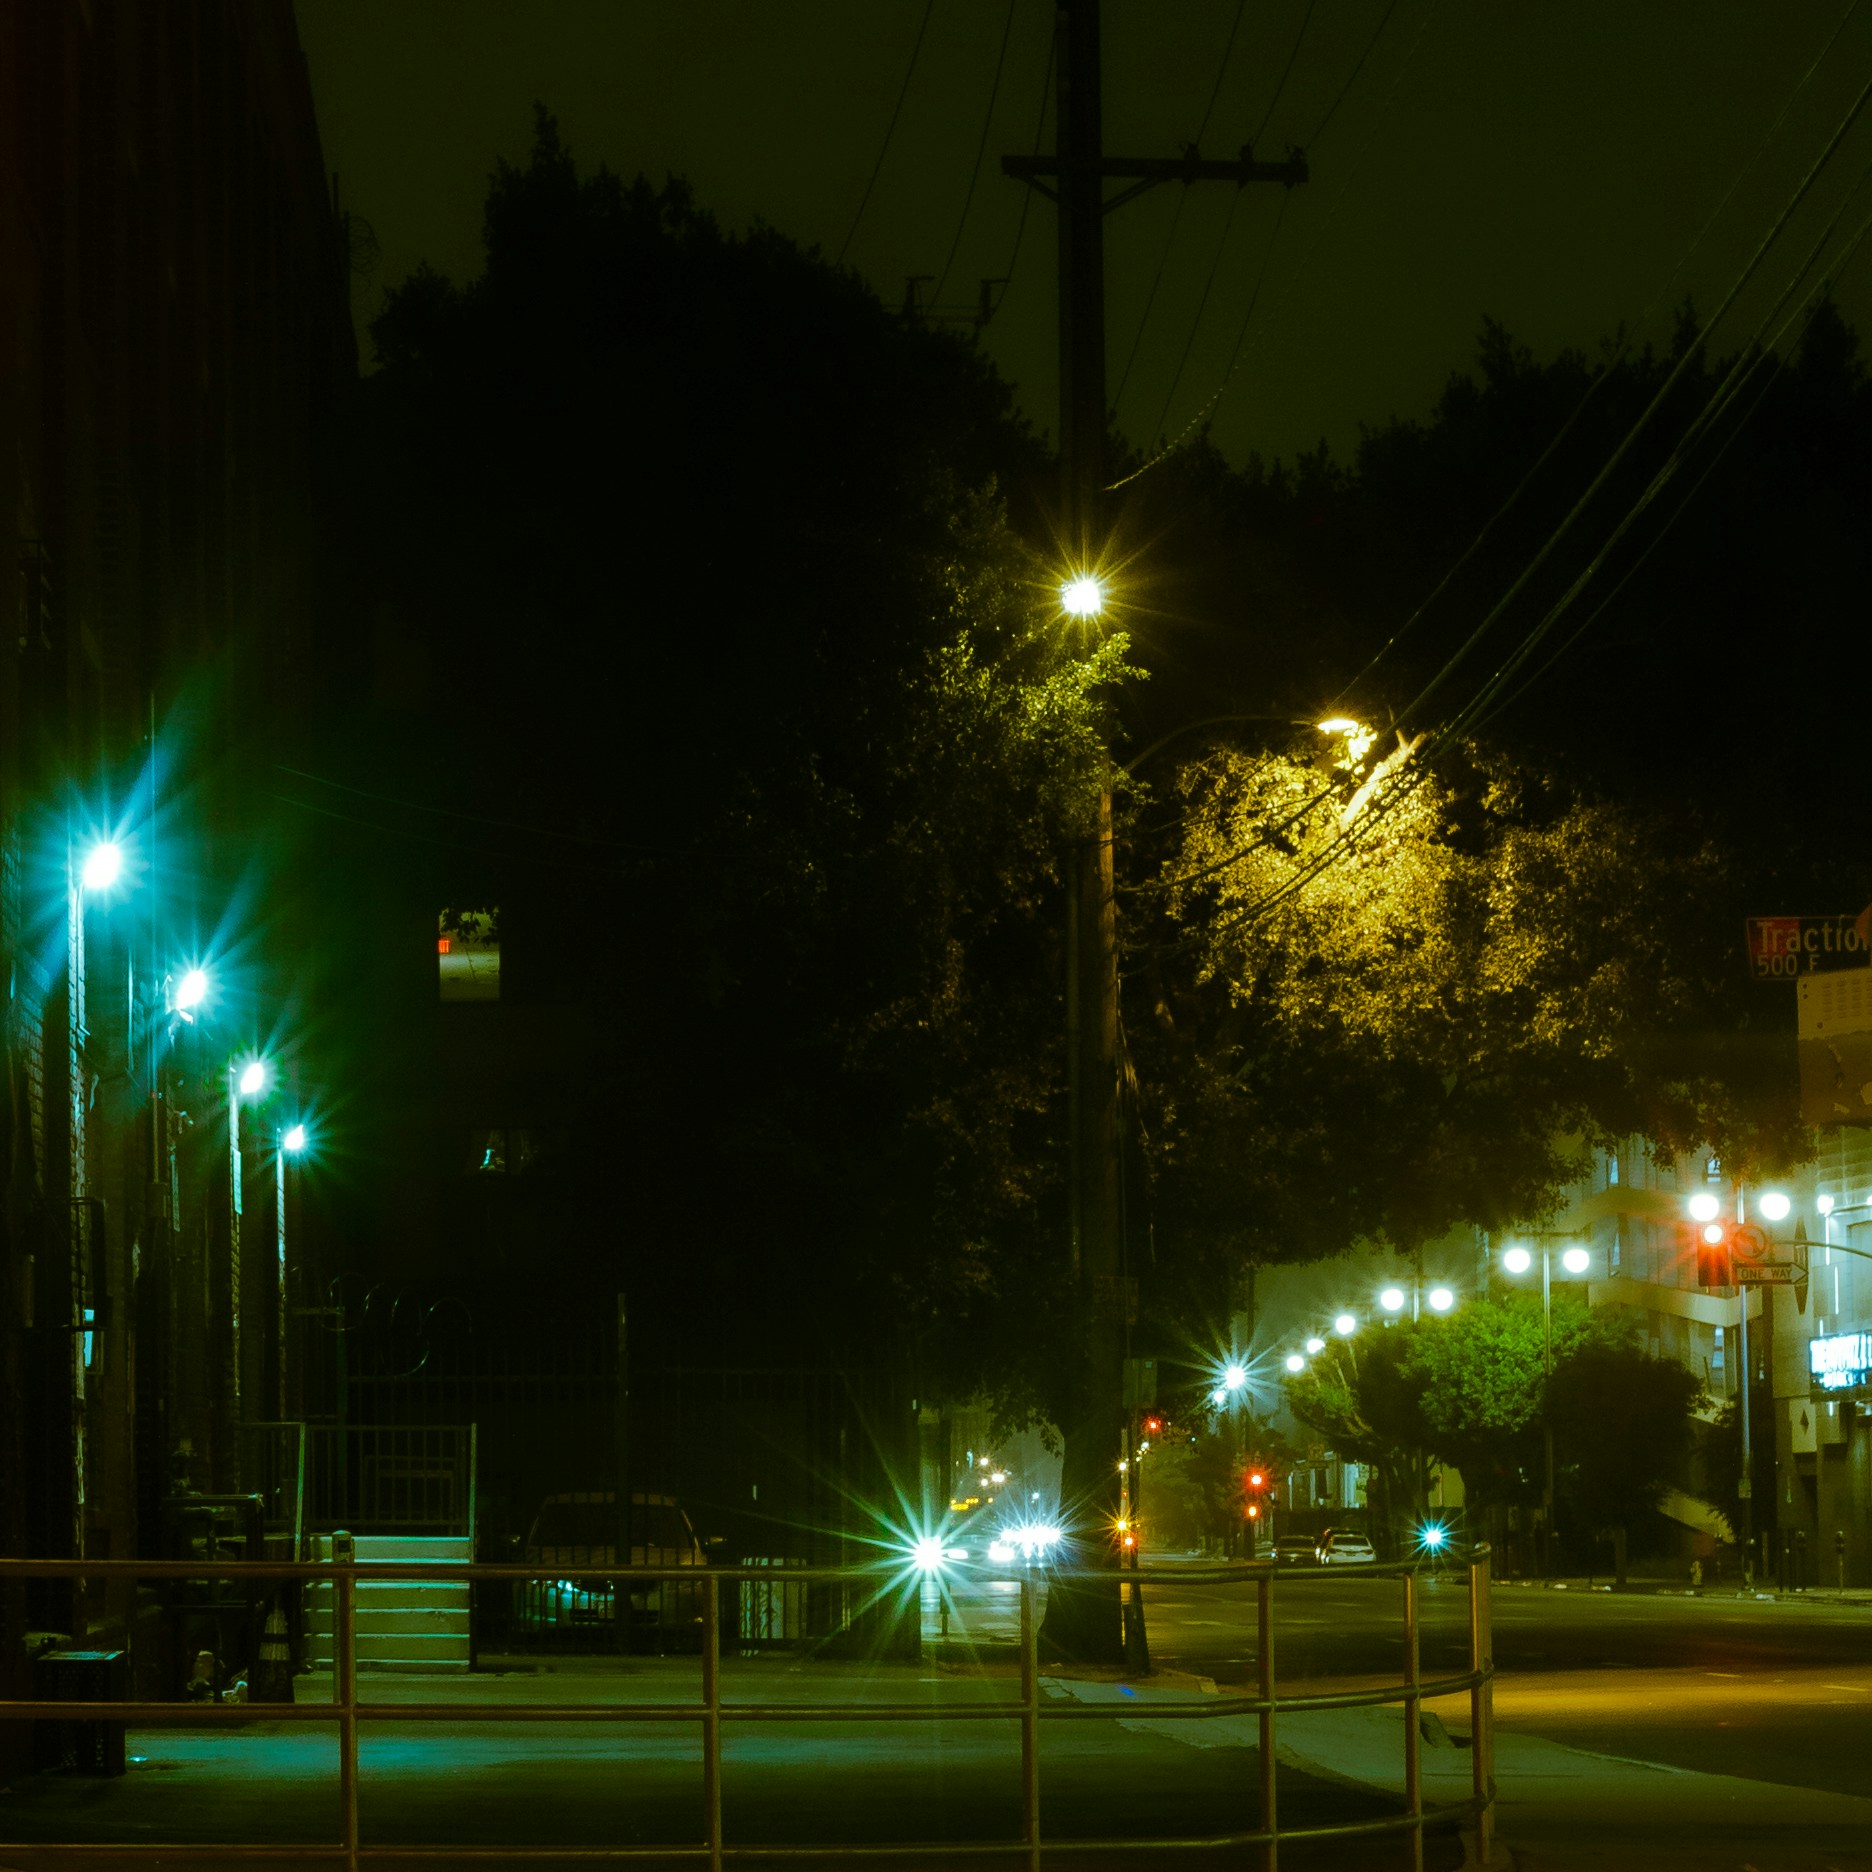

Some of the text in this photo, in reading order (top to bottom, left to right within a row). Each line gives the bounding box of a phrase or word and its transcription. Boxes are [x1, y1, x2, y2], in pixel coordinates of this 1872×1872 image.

[1757, 954, 1797, 977] 500
[1740, 1268, 1793, 1281] ONE WAY
